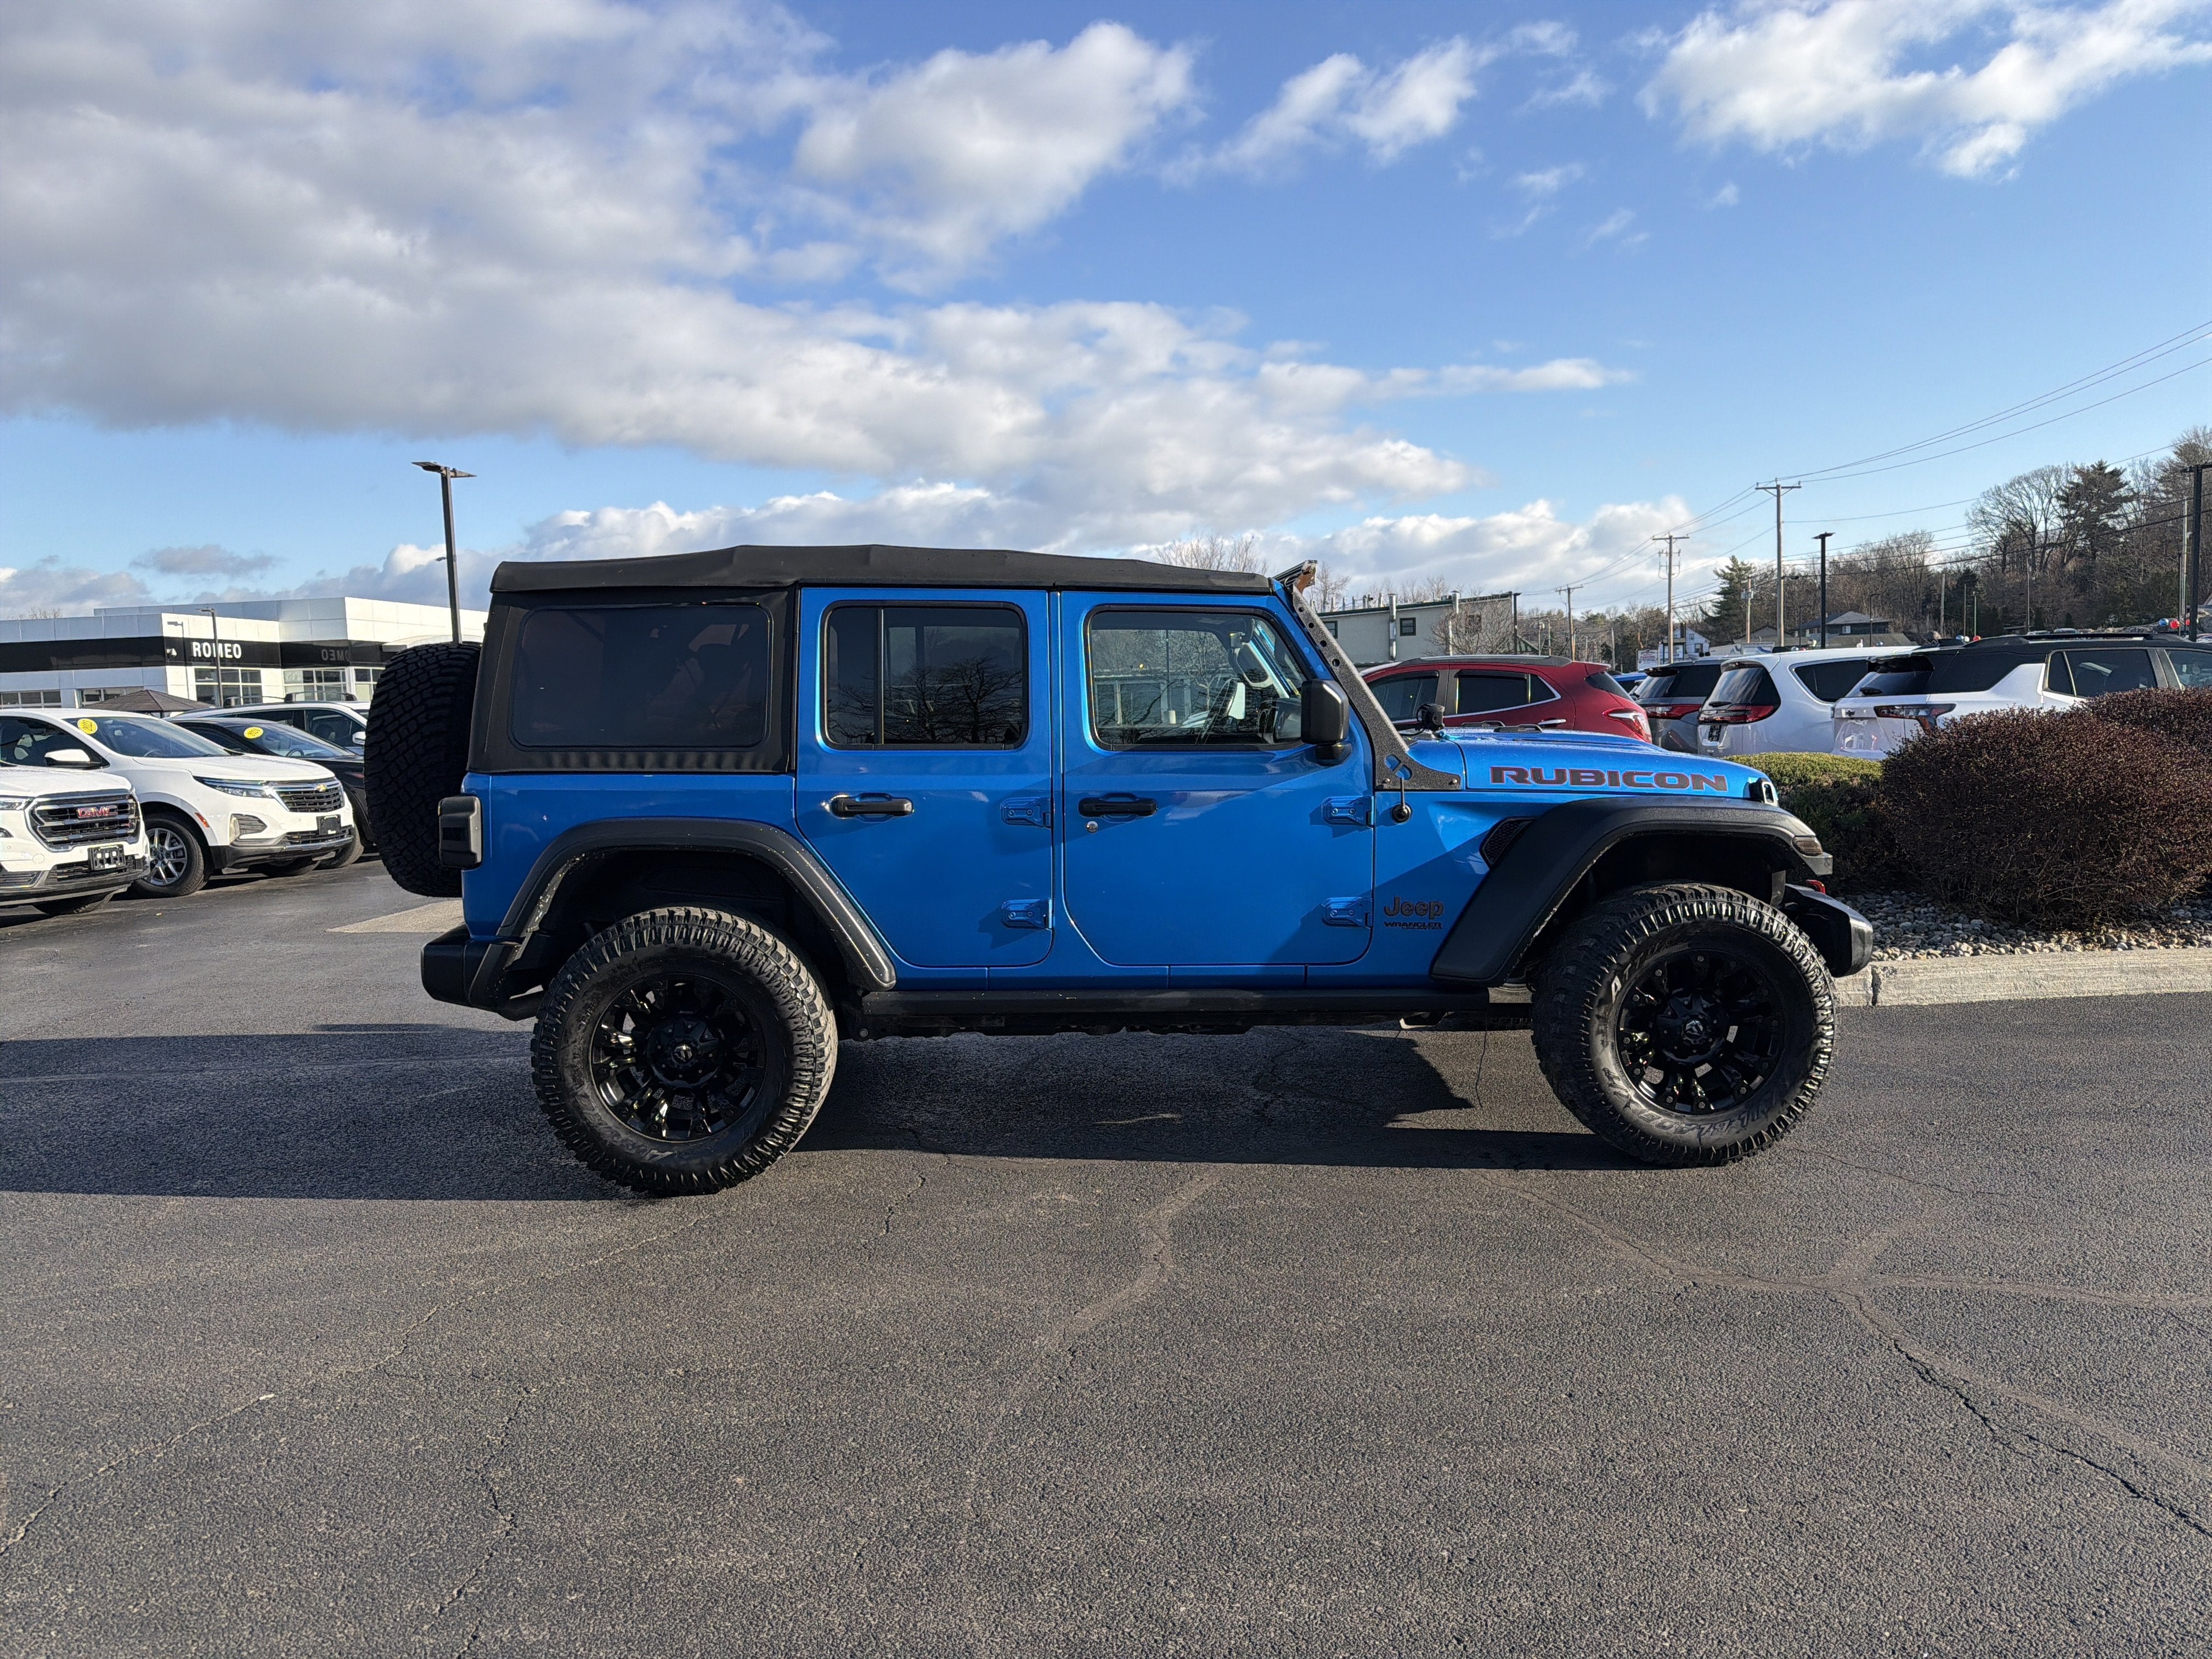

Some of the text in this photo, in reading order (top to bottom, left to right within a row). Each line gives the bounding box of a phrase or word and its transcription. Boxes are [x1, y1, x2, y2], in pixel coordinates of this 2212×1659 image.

[193, 641, 241, 658] ROMEO
[1489, 766, 1728, 791] RUBICON
[77, 805, 118, 818] GMC
[1384, 896, 1444, 919] Jeep
